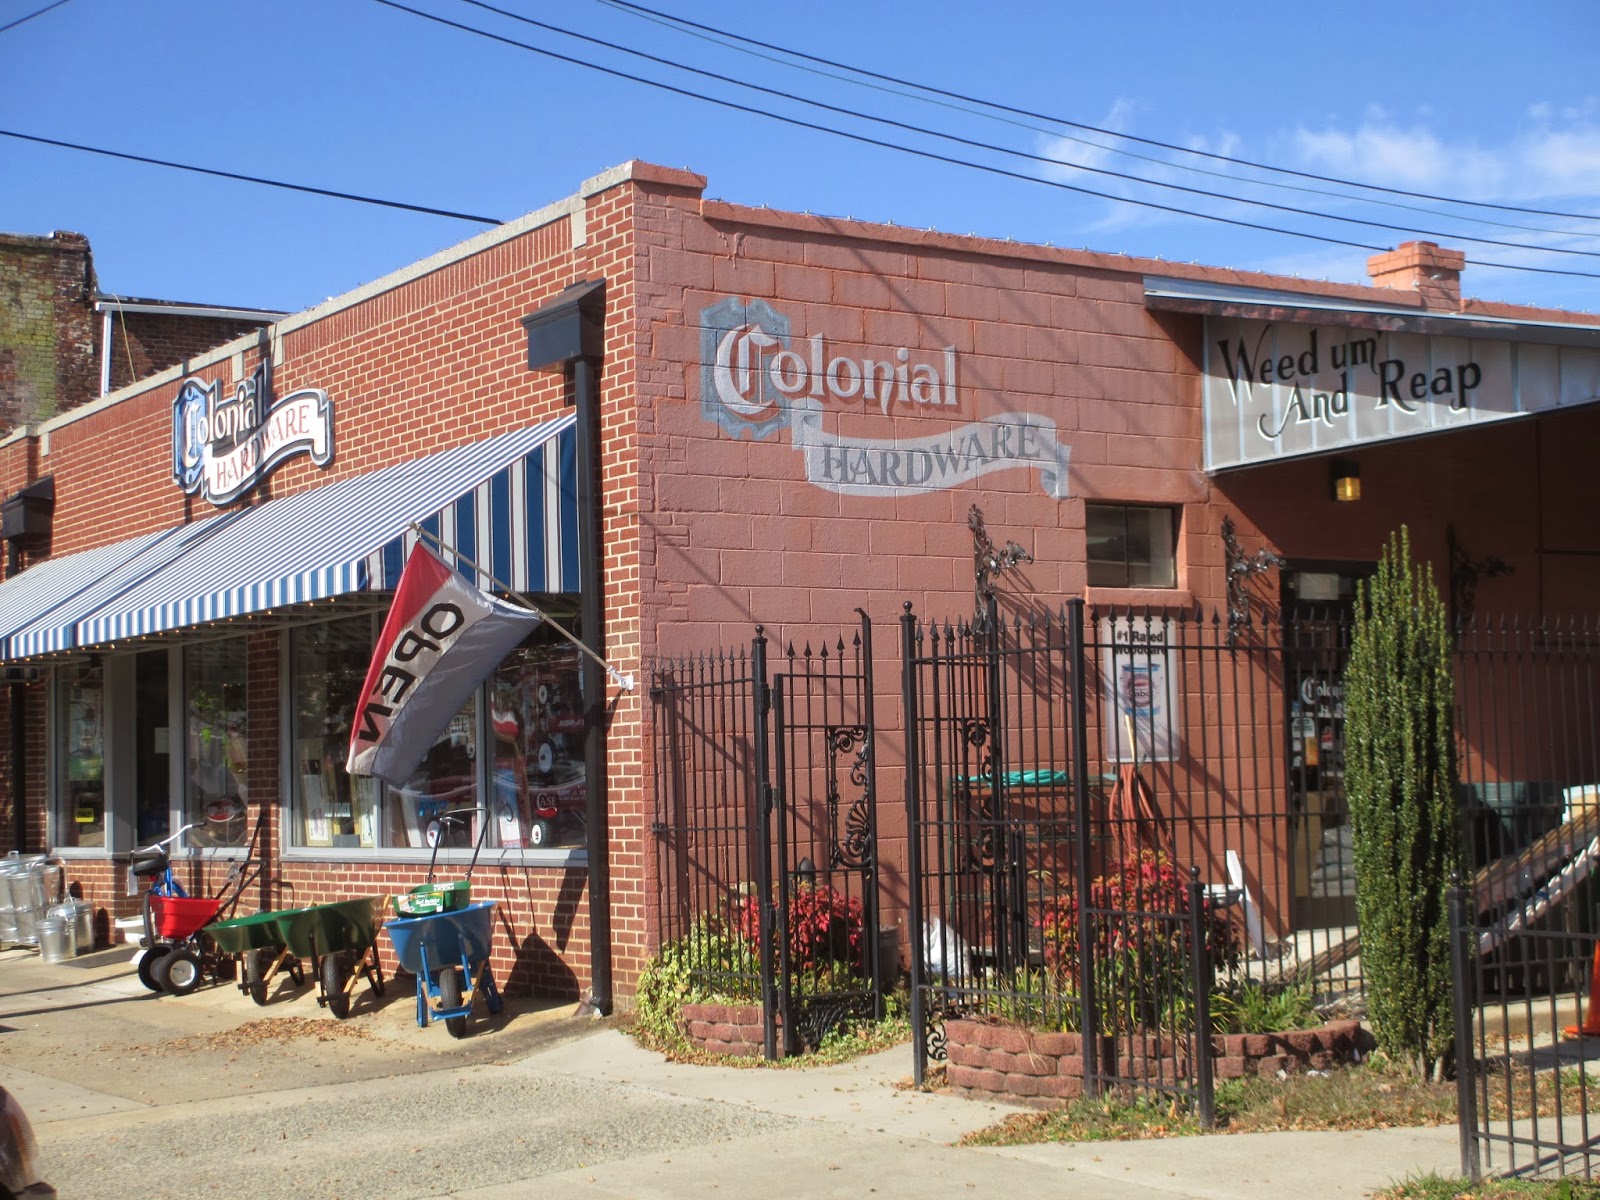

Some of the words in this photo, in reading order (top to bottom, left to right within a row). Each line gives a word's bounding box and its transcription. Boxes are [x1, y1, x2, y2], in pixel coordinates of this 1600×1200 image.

[714, 323, 958, 417] Colonial
[1217, 324, 1319, 404] Weed
[1257, 372, 1348, 439] And
[1377, 359, 1482, 413] Reap
[182, 374, 265, 467] Colonial
[216, 404, 310, 490] HARDWARE
[821, 424, 1042, 486] HARDWARE
[1116, 630, 1129, 642] #1
[1131, 631, 1164, 642] Raed
[1128, 689, 1153, 697] Cabo
